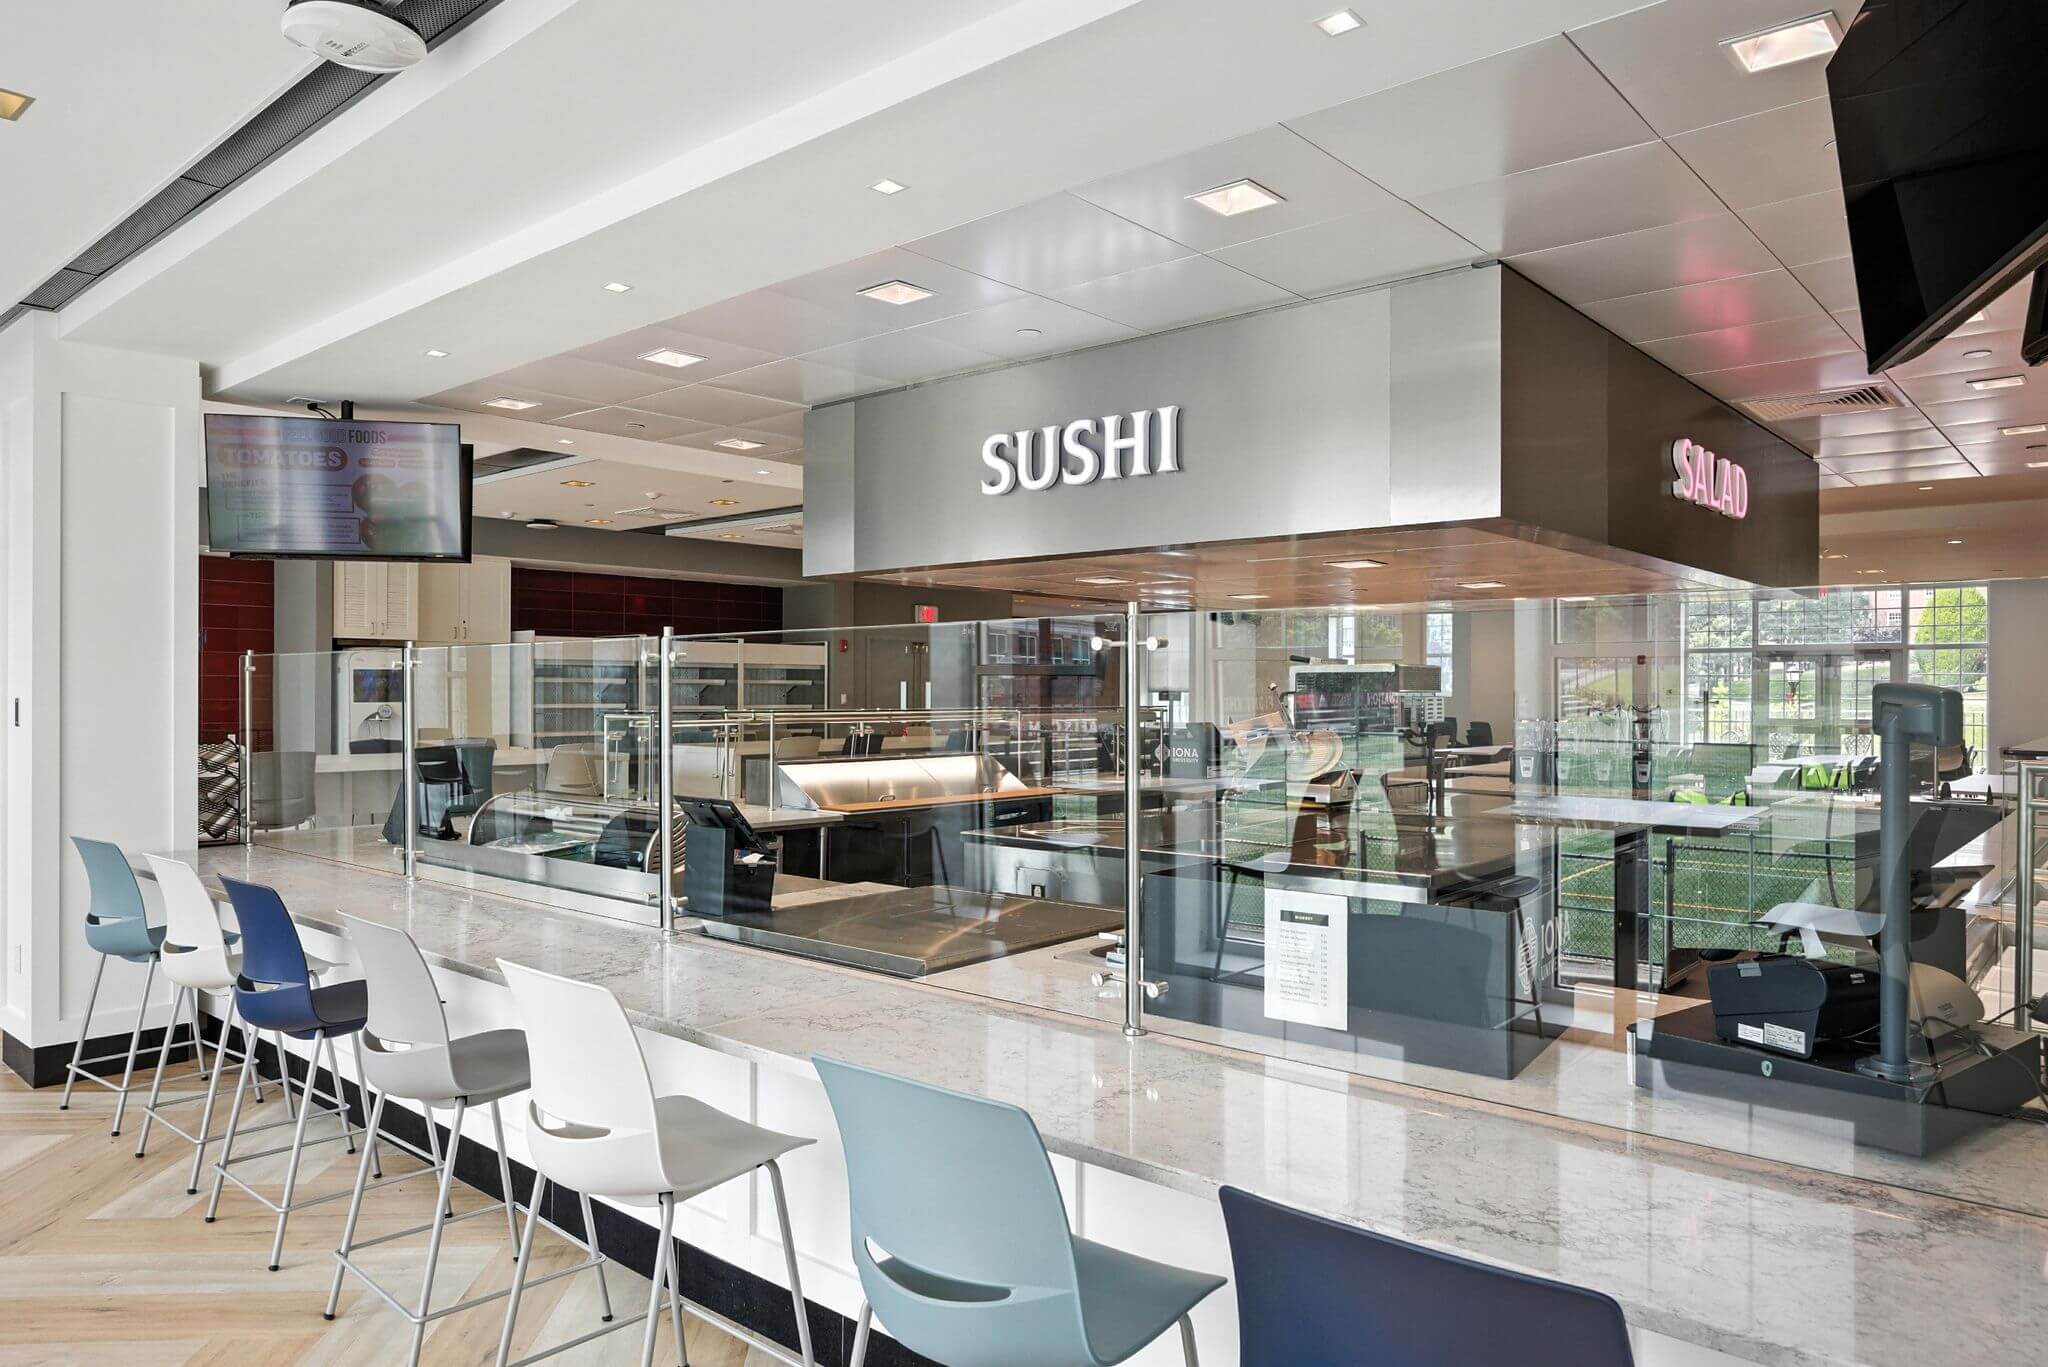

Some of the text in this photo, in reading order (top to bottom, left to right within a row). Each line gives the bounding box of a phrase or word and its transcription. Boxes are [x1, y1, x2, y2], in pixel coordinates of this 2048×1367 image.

[348, 429, 386, 444] FOODS
[223, 447, 342, 467] TOMATOES
[980, 405, 1181, 495] SUSHI
[1672, 438, 1748, 519] SALAD
[1172, 747, 1199, 758] IONA
